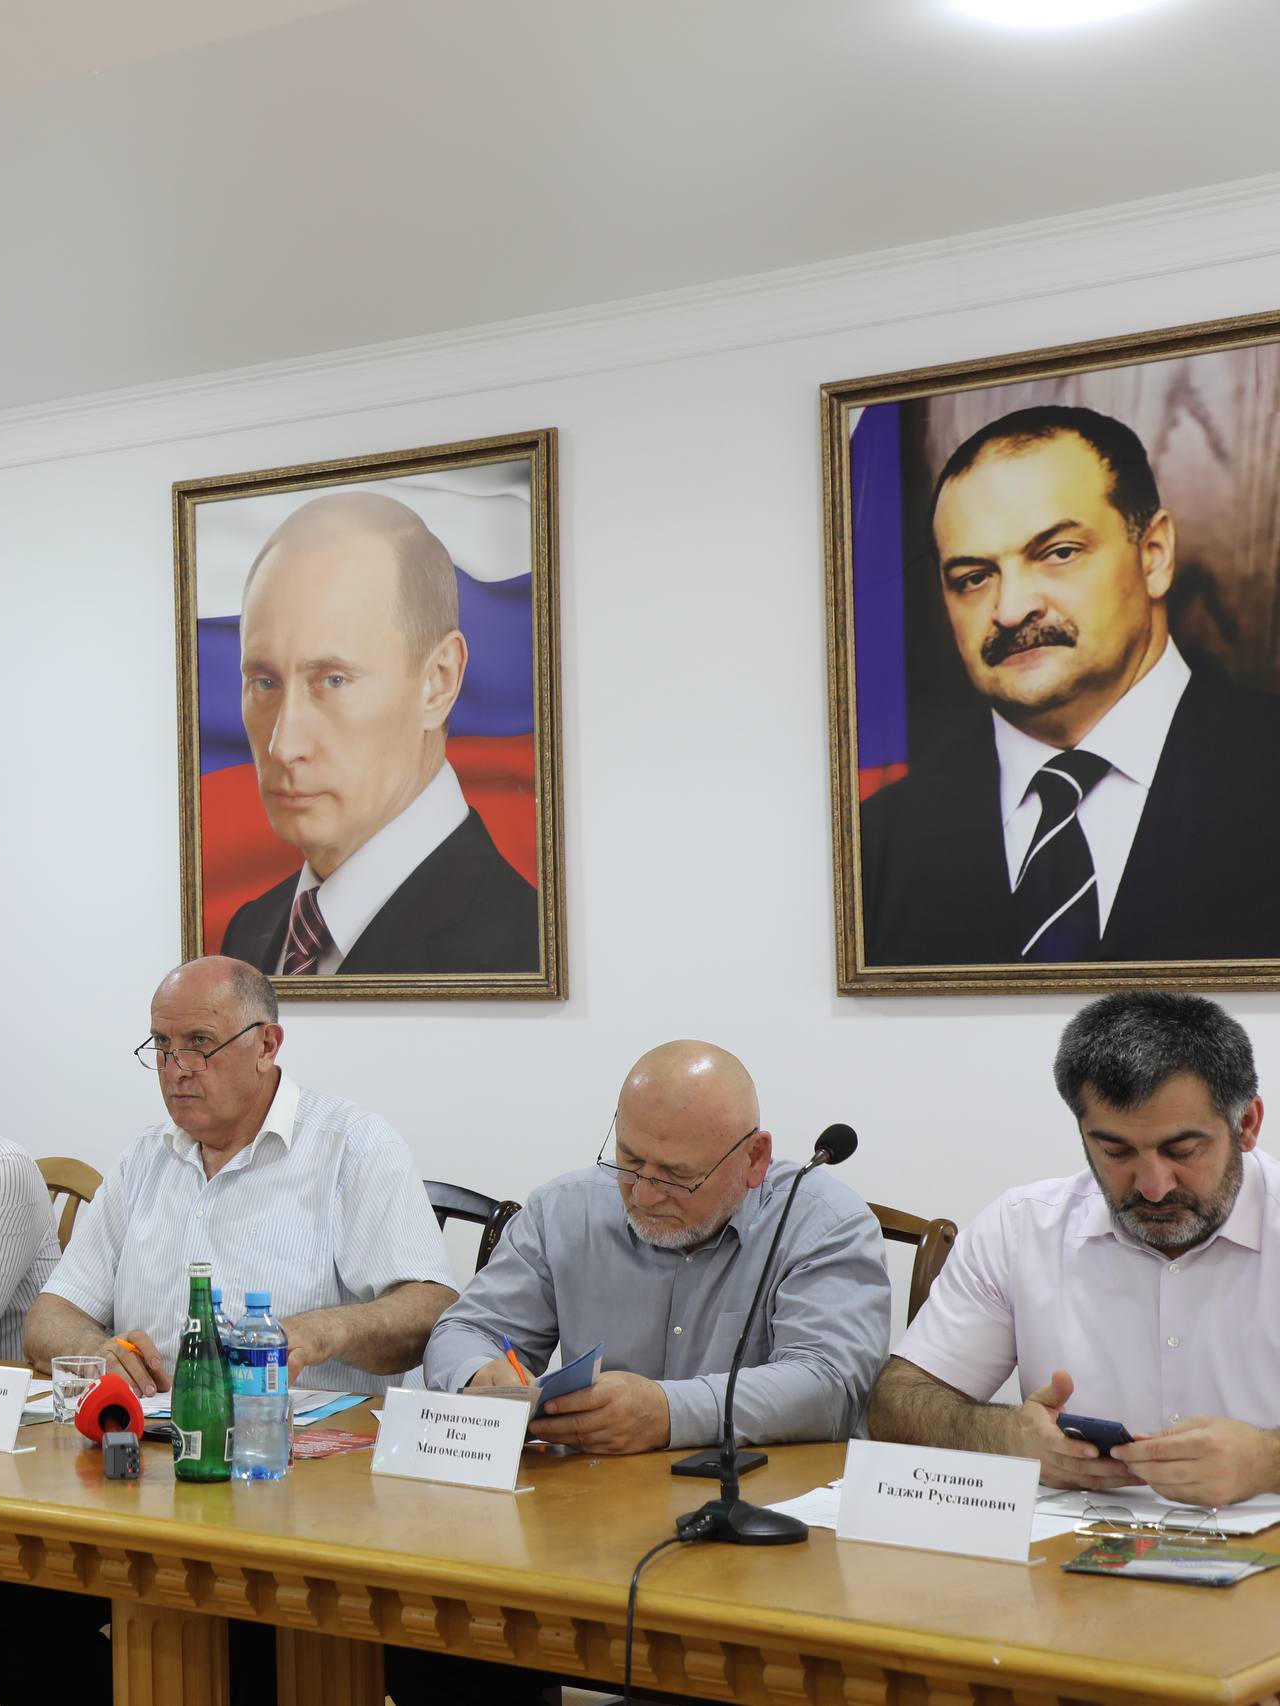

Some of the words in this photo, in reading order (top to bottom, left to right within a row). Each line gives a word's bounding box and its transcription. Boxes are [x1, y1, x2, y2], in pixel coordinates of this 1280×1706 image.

[420, 1408, 500, 1428] Нурмагомедов
[446, 1428, 467, 1441] Иса
[416, 1441, 492, 1461] Магомедович
[913, 1467, 985, 1488] Султанов
[877, 1482, 923, 1500] Гаджи
[928, 1488, 1017, 1512] Русланович
